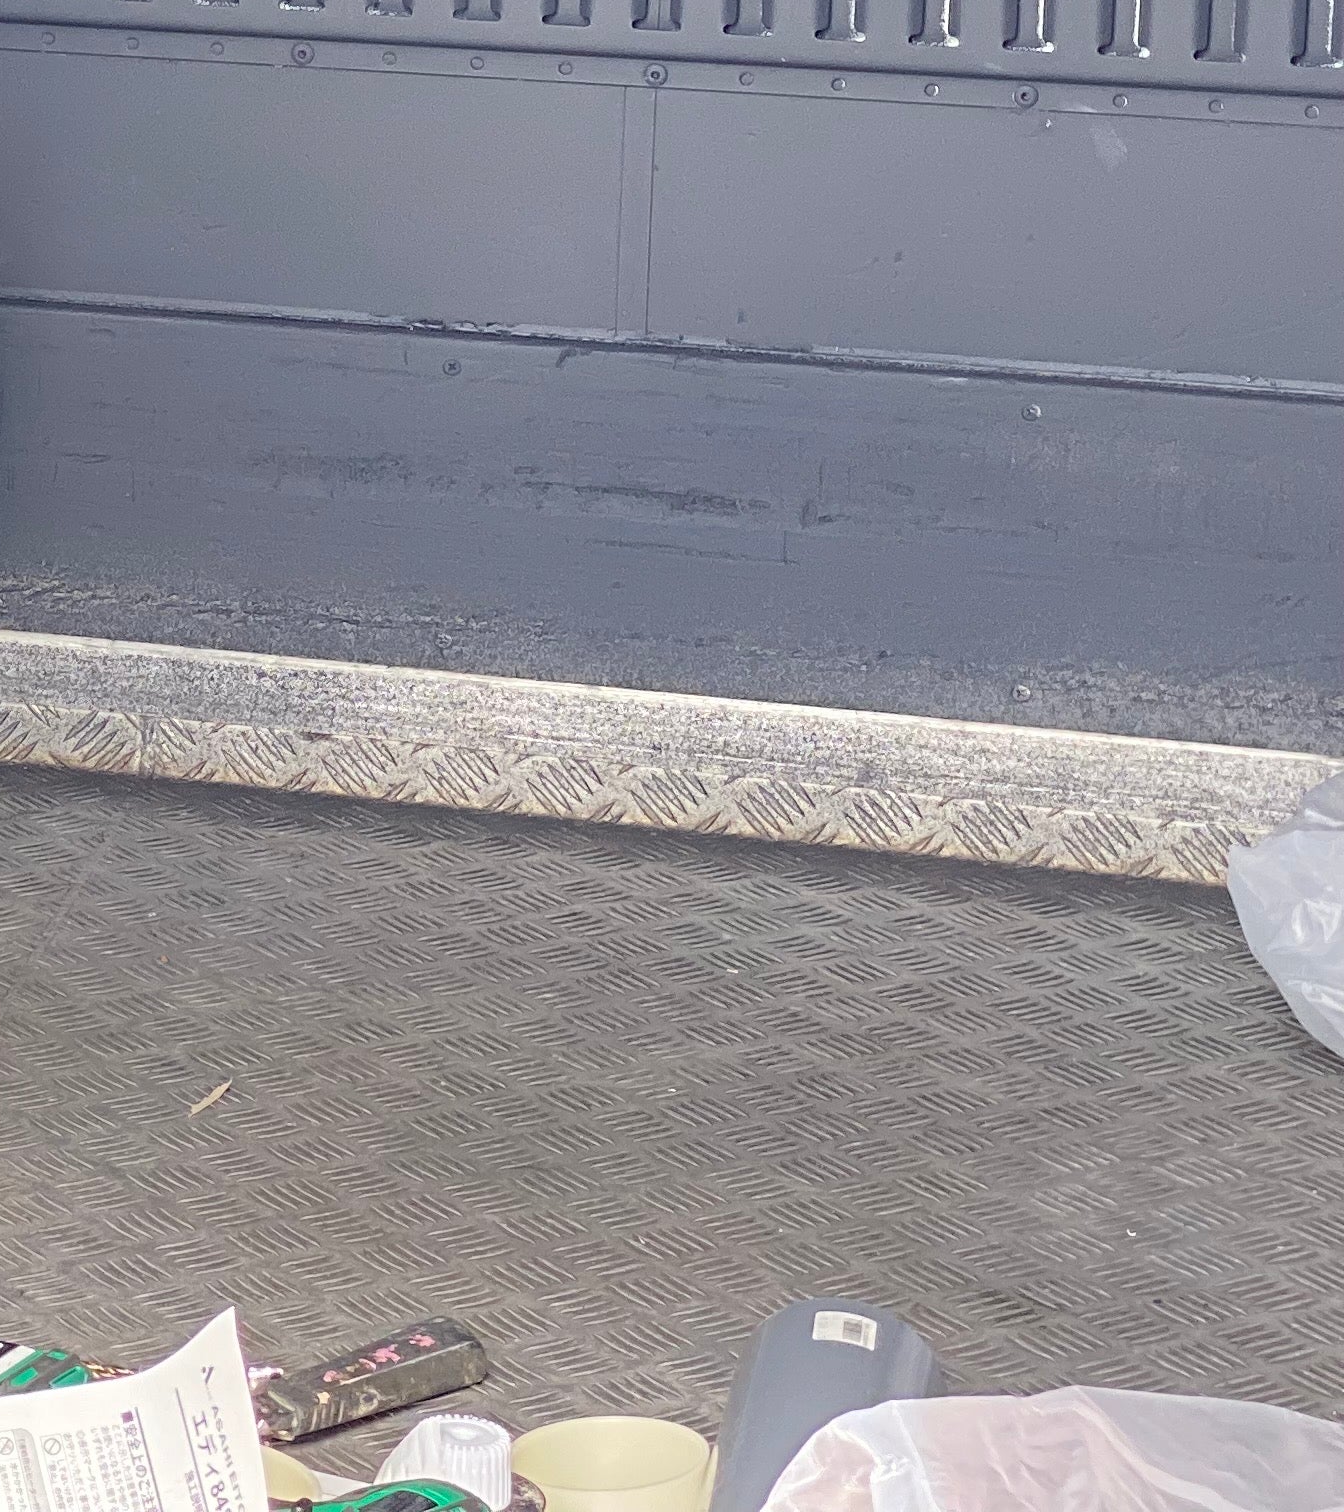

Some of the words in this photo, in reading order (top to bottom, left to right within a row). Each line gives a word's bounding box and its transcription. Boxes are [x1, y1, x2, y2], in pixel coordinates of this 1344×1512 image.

[193, 1410, 231, 1512] エディ84
[211, 1406, 234, 1468] ASAHI
